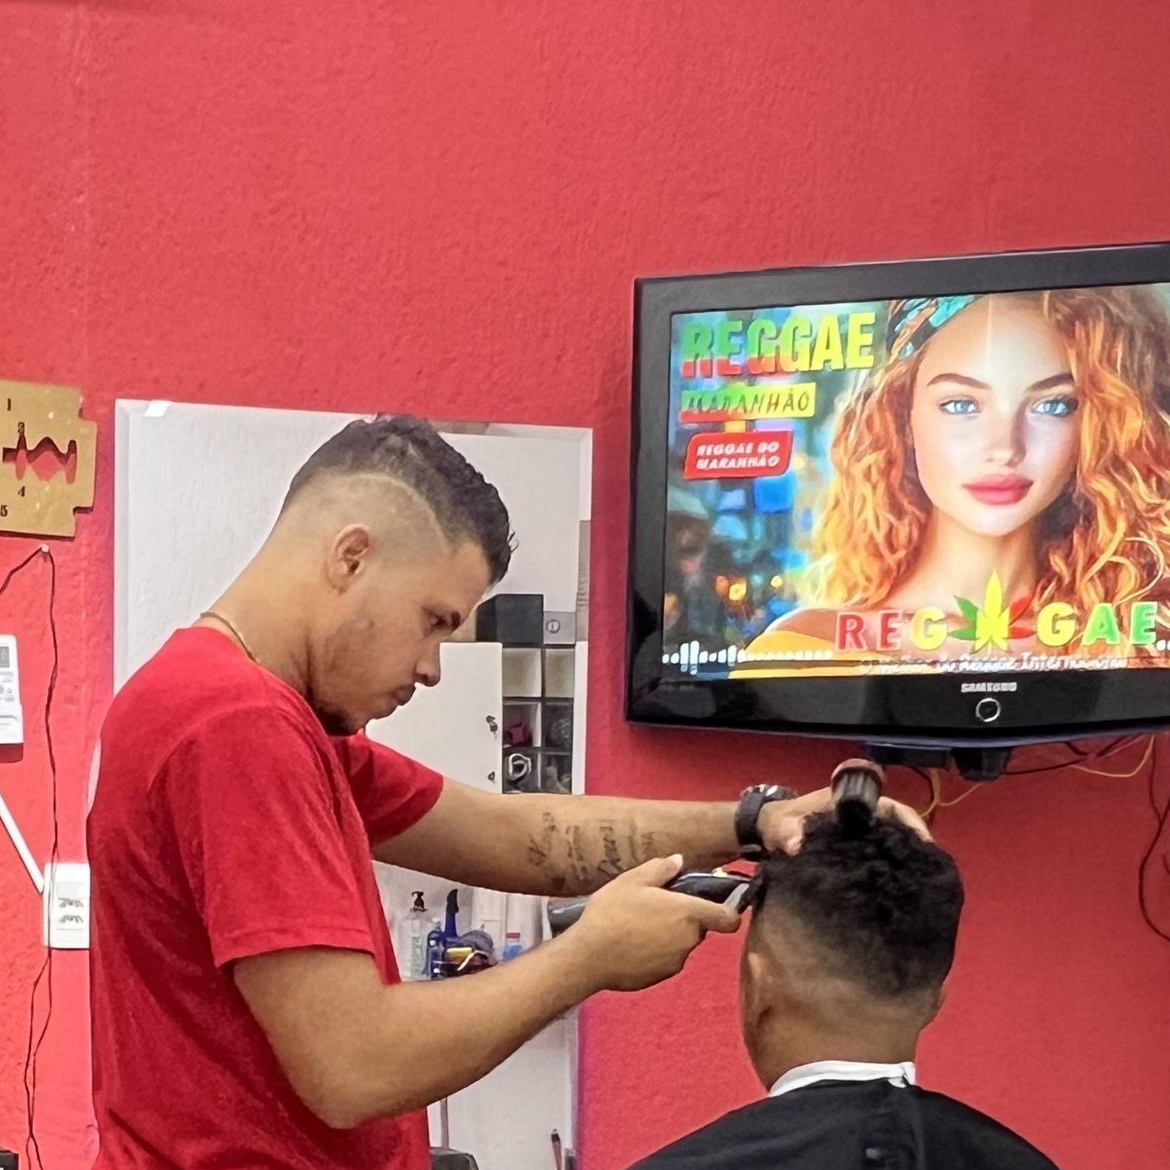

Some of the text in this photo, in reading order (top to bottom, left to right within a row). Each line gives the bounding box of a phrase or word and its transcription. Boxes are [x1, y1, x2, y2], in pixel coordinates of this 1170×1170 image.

[682, 312, 876, 379] REGGAE
[6, 398, 12, 411] 1
[696, 440, 780, 456] REGGAE DO
[17, 486, 26, 497] 4
[0, 505, 8, 517] 5
